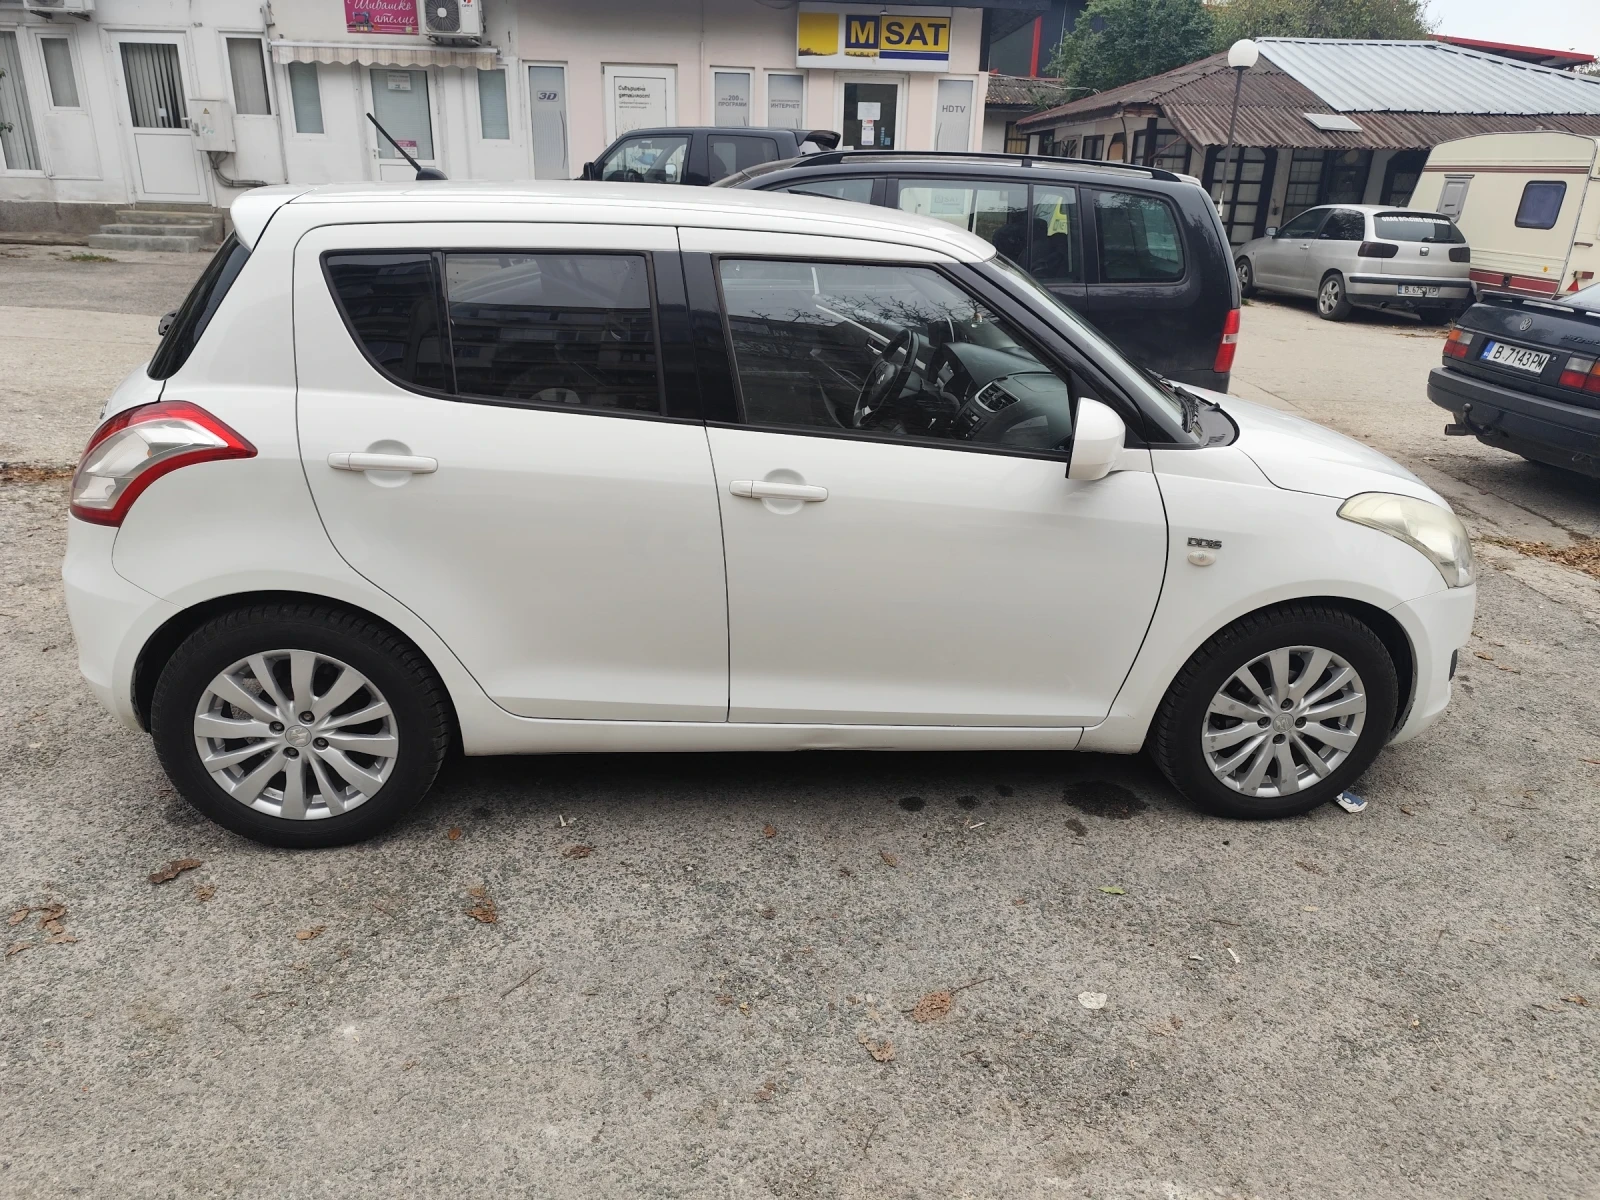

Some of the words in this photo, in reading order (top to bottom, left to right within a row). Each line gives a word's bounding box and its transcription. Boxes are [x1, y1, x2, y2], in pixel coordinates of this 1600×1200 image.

[374, 13, 415, 24] ателие
[850, 21, 875, 44] M
[884, 21, 947, 46] SAT
[538, 92, 557, 101] 3D
[942, 105, 966, 113] HDTV
